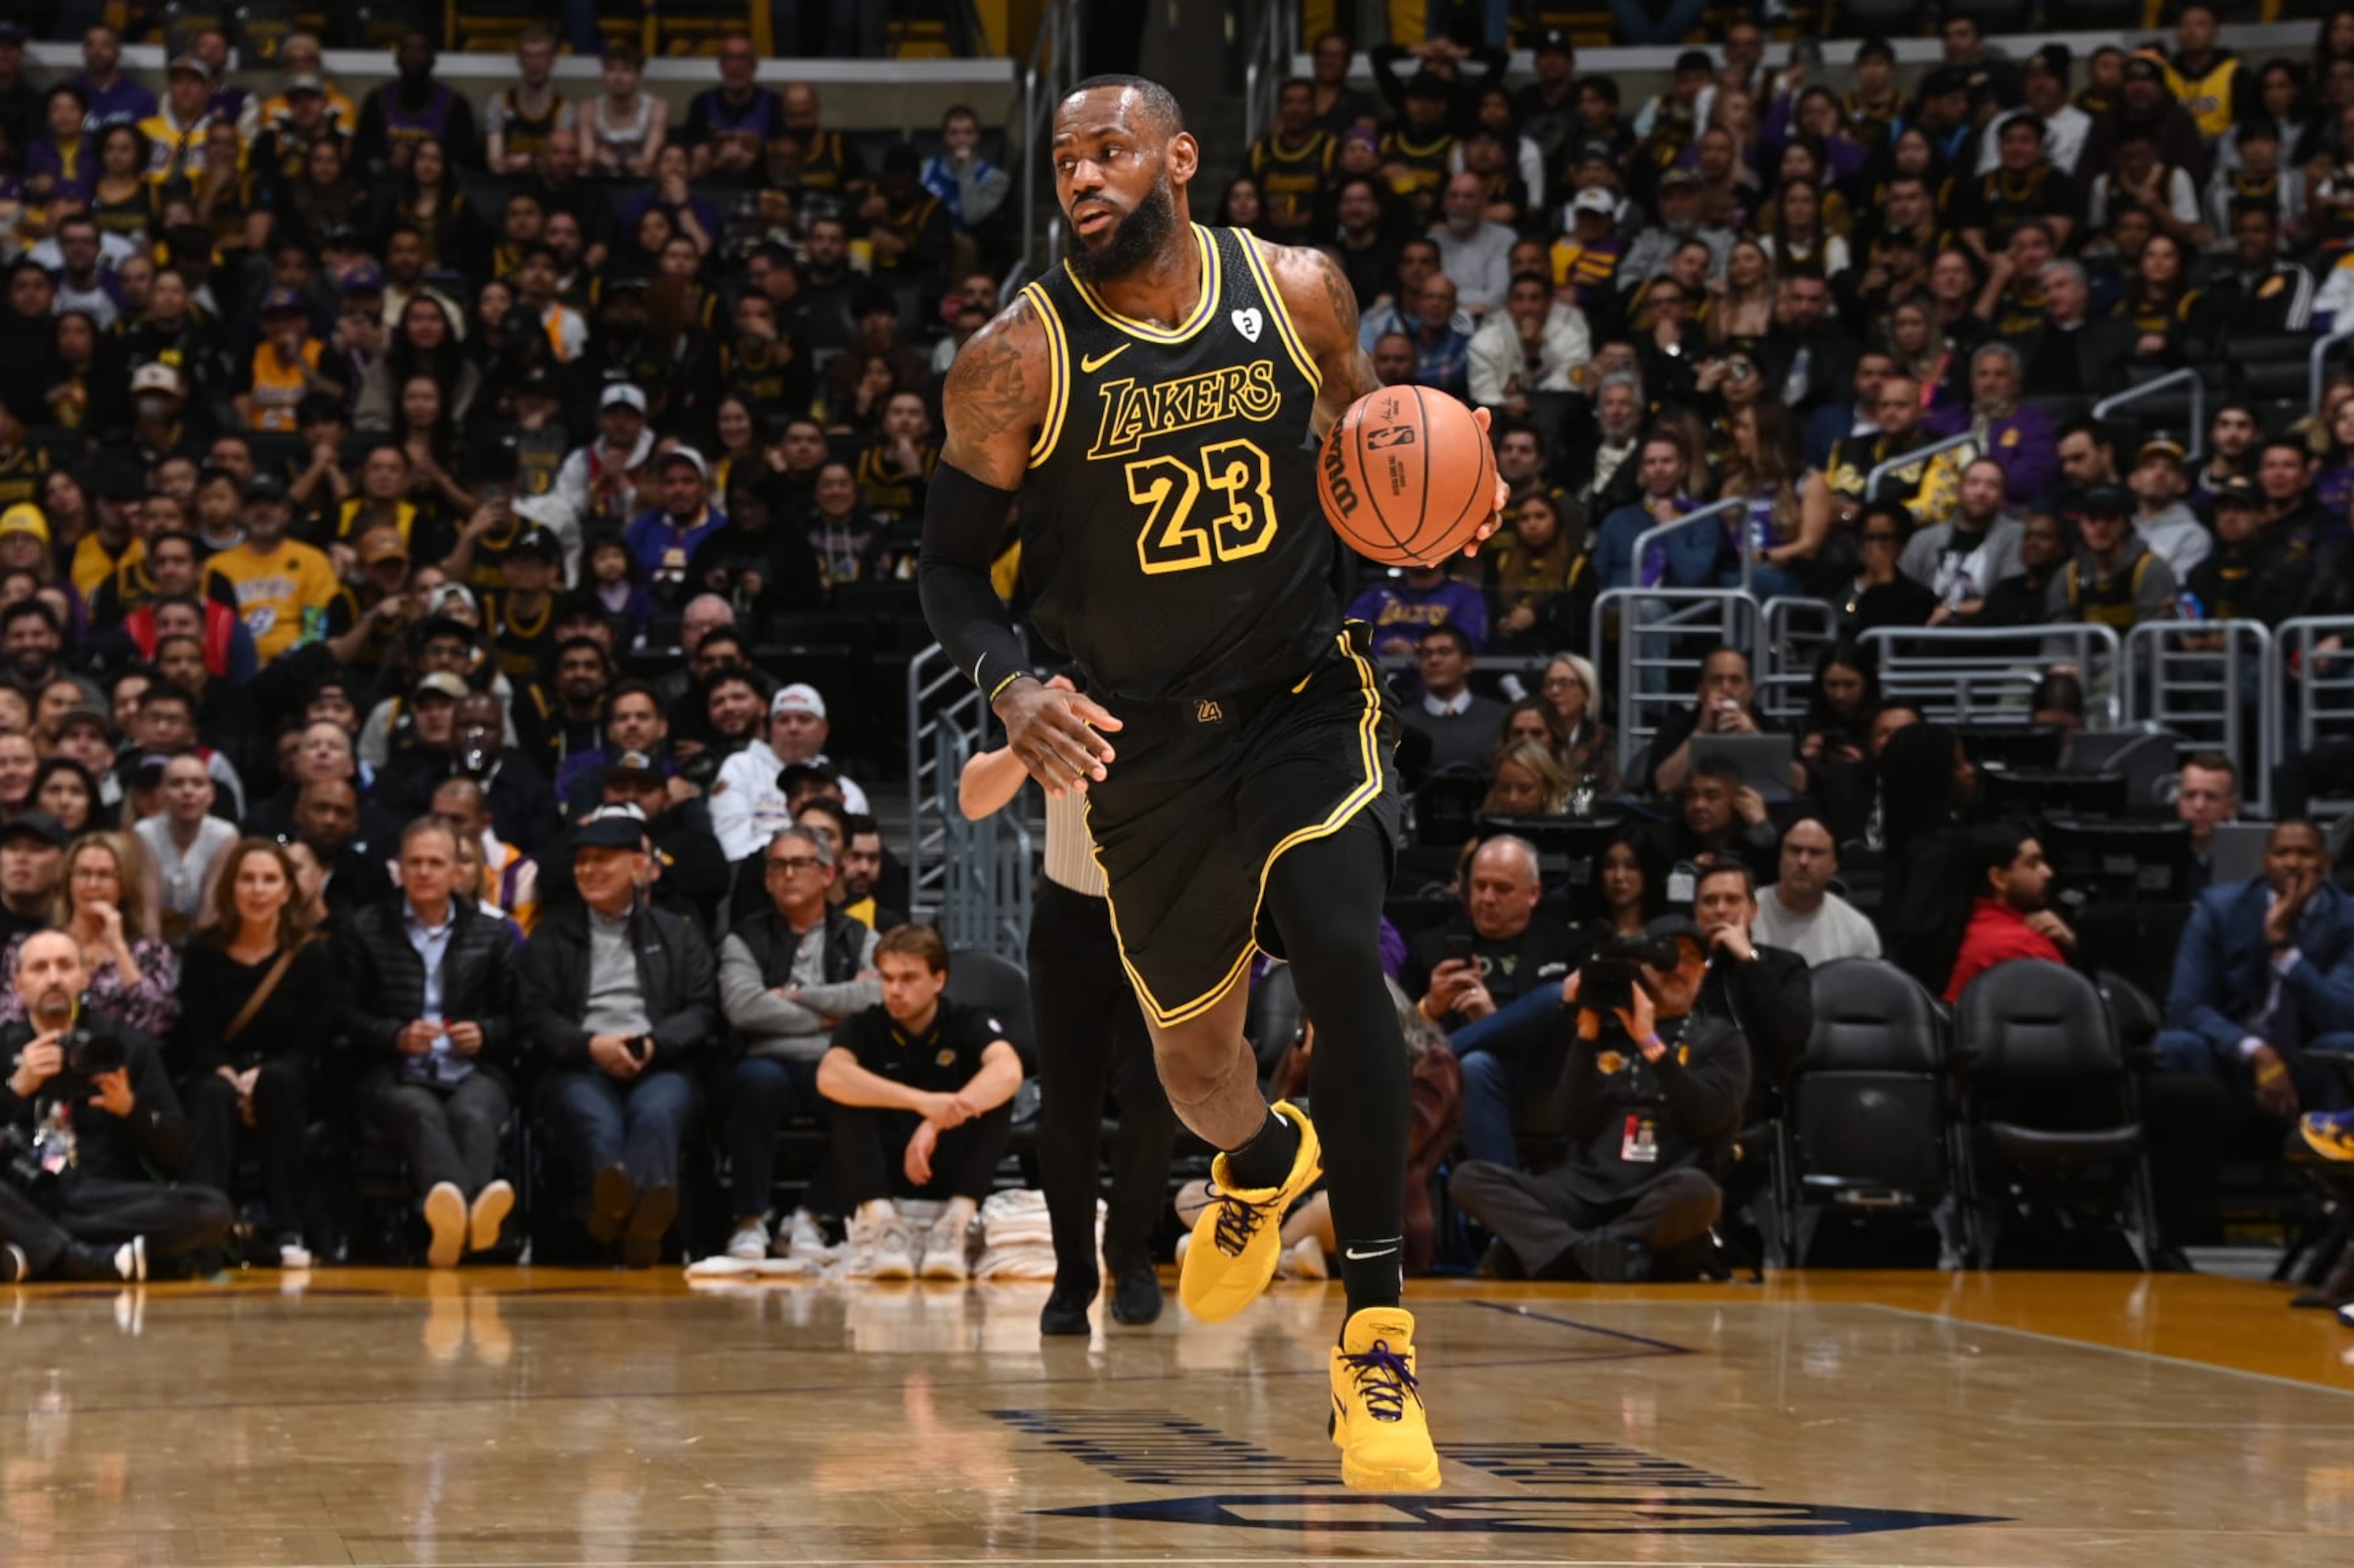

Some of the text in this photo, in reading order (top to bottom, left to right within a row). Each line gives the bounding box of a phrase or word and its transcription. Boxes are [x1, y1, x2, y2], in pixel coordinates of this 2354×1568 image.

[1243, 316, 1255, 335] 2
[1087, 360, 1281, 460] LAKERS
[1125, 438, 1278, 575] 23
[1433, 1442, 1766, 1490] ARENA
